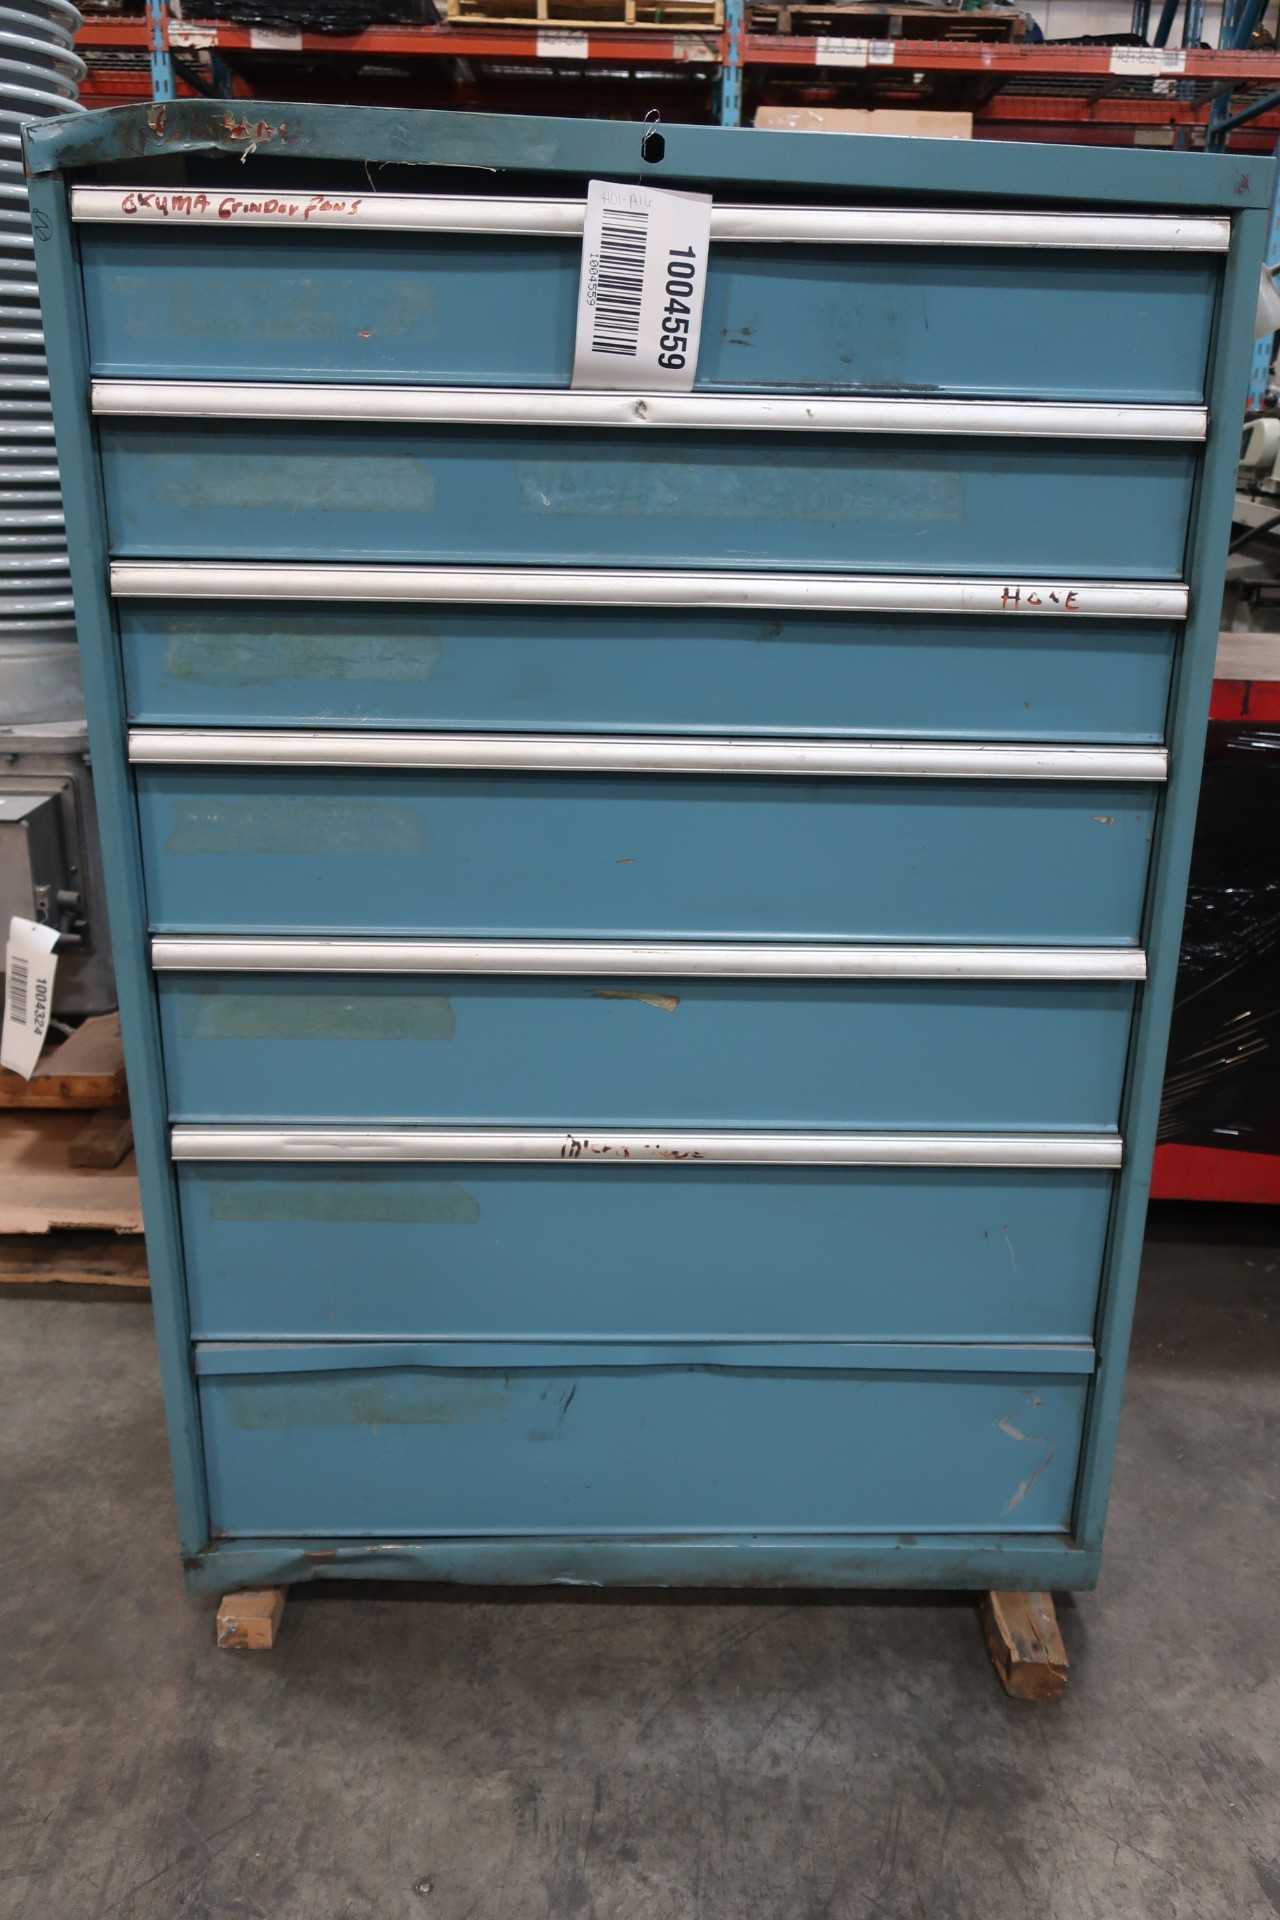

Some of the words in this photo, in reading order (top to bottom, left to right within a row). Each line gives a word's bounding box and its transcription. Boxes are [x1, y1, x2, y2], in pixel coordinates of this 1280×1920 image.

[586, 253, 600, 306] 1004559
[658, 246, 696, 370] 1004559
[34, 979, 48, 1036] 1004324
